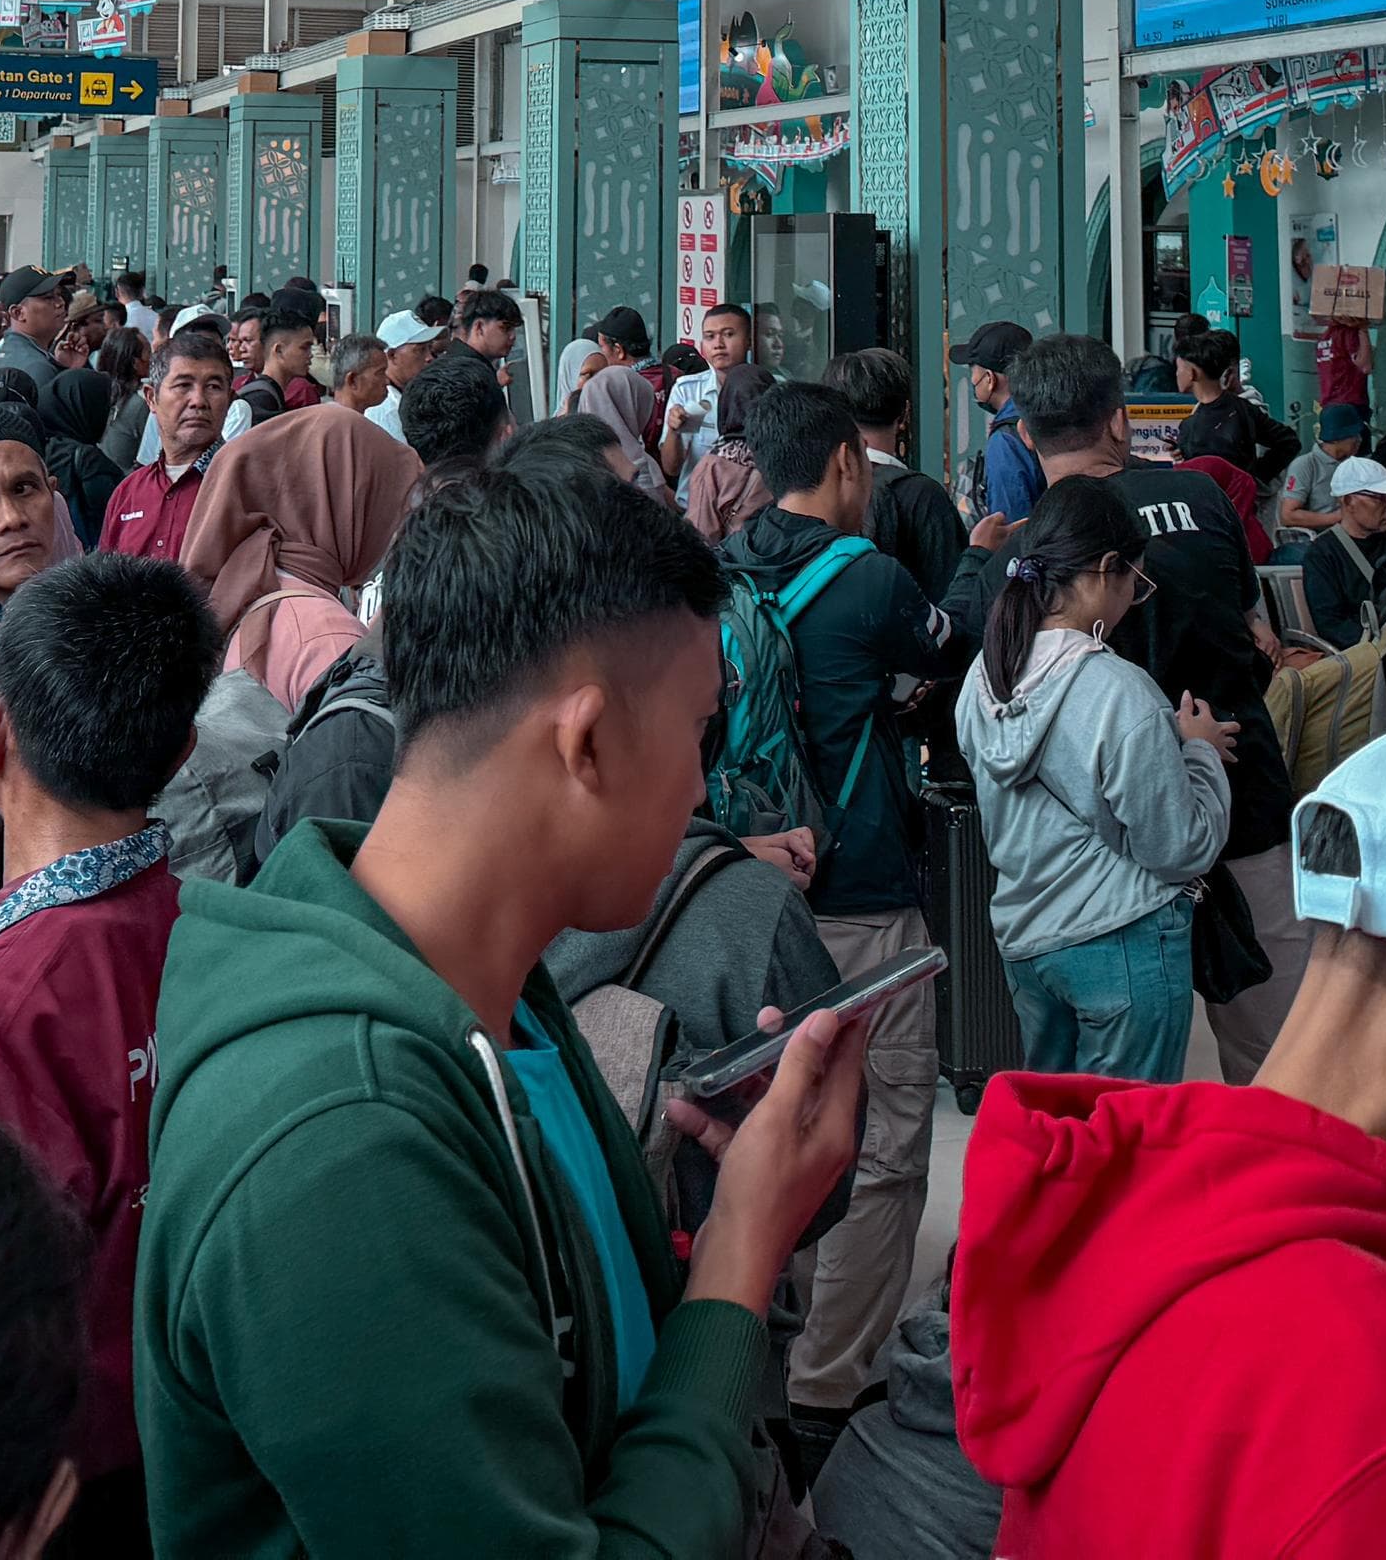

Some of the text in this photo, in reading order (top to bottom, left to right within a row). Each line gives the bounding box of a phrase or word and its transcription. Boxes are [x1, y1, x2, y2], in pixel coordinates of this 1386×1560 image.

[27, 69, 63, 84] Gate
[66, 72, 73, 84] 1
[12, 88, 72, 101] Departures
[1137, 500, 1201, 537] TIR
